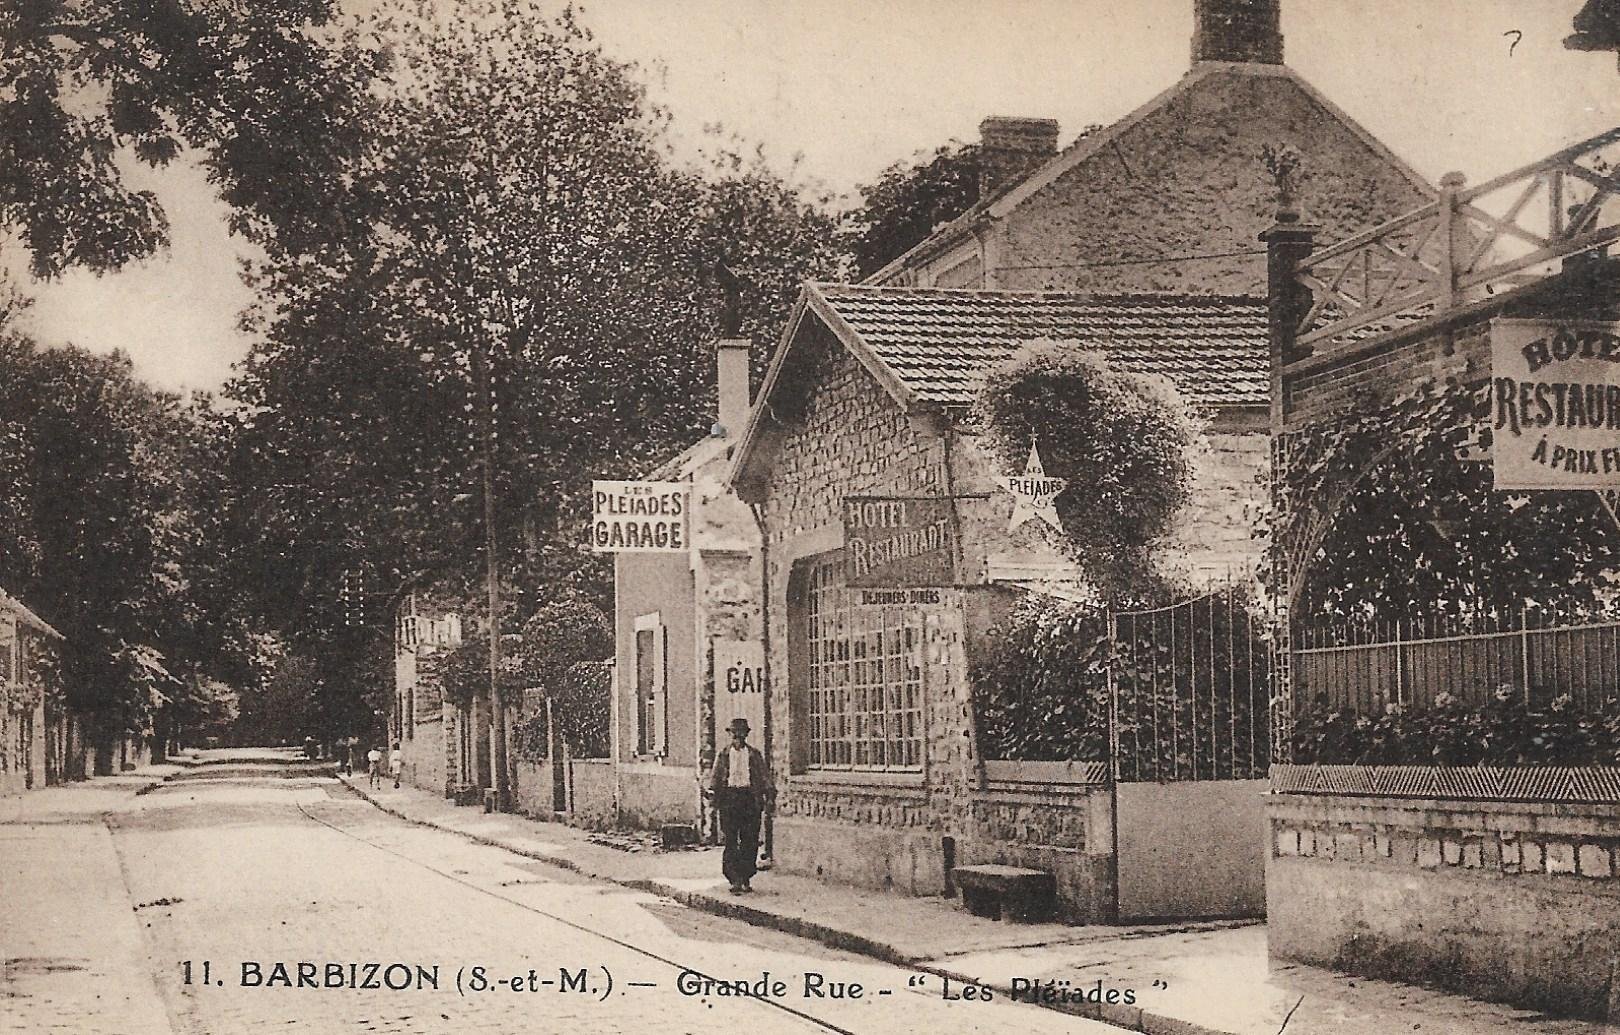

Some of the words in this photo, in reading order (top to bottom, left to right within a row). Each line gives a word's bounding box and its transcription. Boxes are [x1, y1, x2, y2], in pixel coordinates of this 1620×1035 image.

[1551, 444, 1598, 474] PRIX
[595, 490, 682, 516] PLEIADES
[624, 486, 653, 495] LES
[595, 520, 682, 549] GARAGE
[848, 517, 948, 578] RESTAURANT
